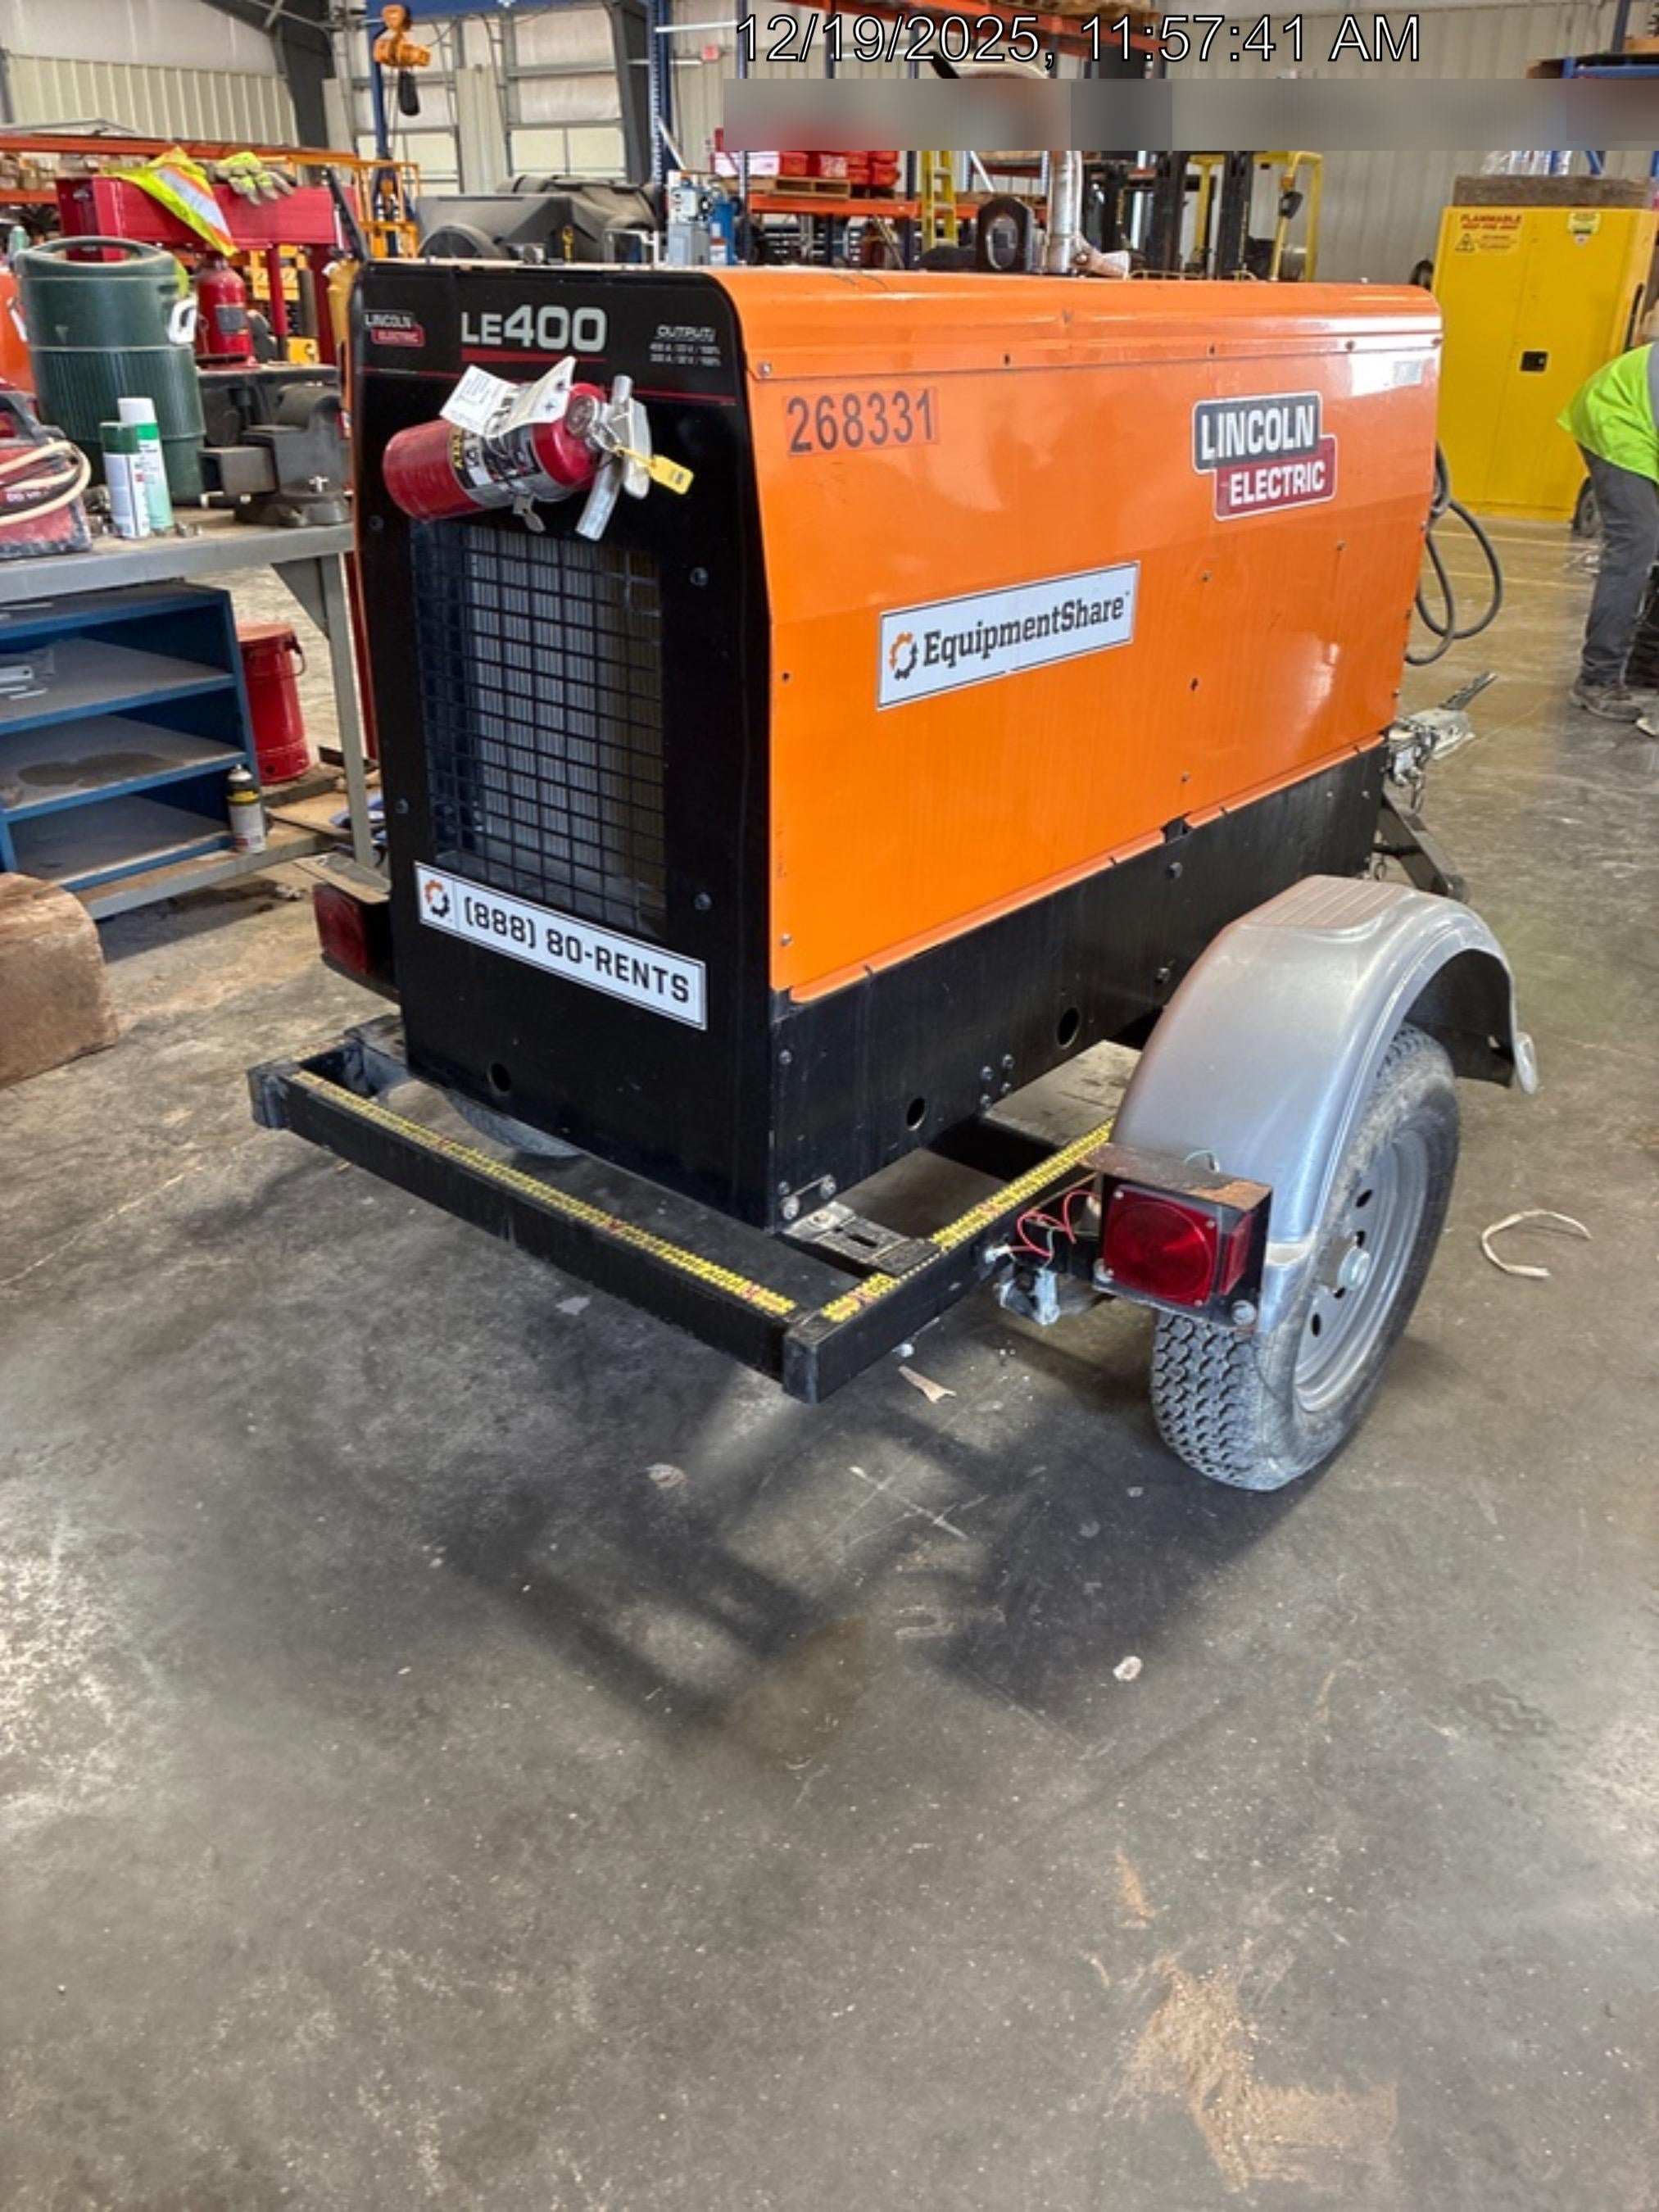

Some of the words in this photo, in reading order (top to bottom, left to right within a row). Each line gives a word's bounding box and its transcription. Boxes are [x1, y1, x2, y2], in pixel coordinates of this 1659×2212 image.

[460, 304, 606, 352] LE400
[786, 389, 932, 452] 268331
[1201, 405, 1315, 460] LINCOLN
[1230, 460, 1326, 506] ELECTRIC
[922, 596, 1125, 669] EquipmentShare
[465, 896, 537, 949] (888)
[546, 927, 690, 1004] 80-RENTS
